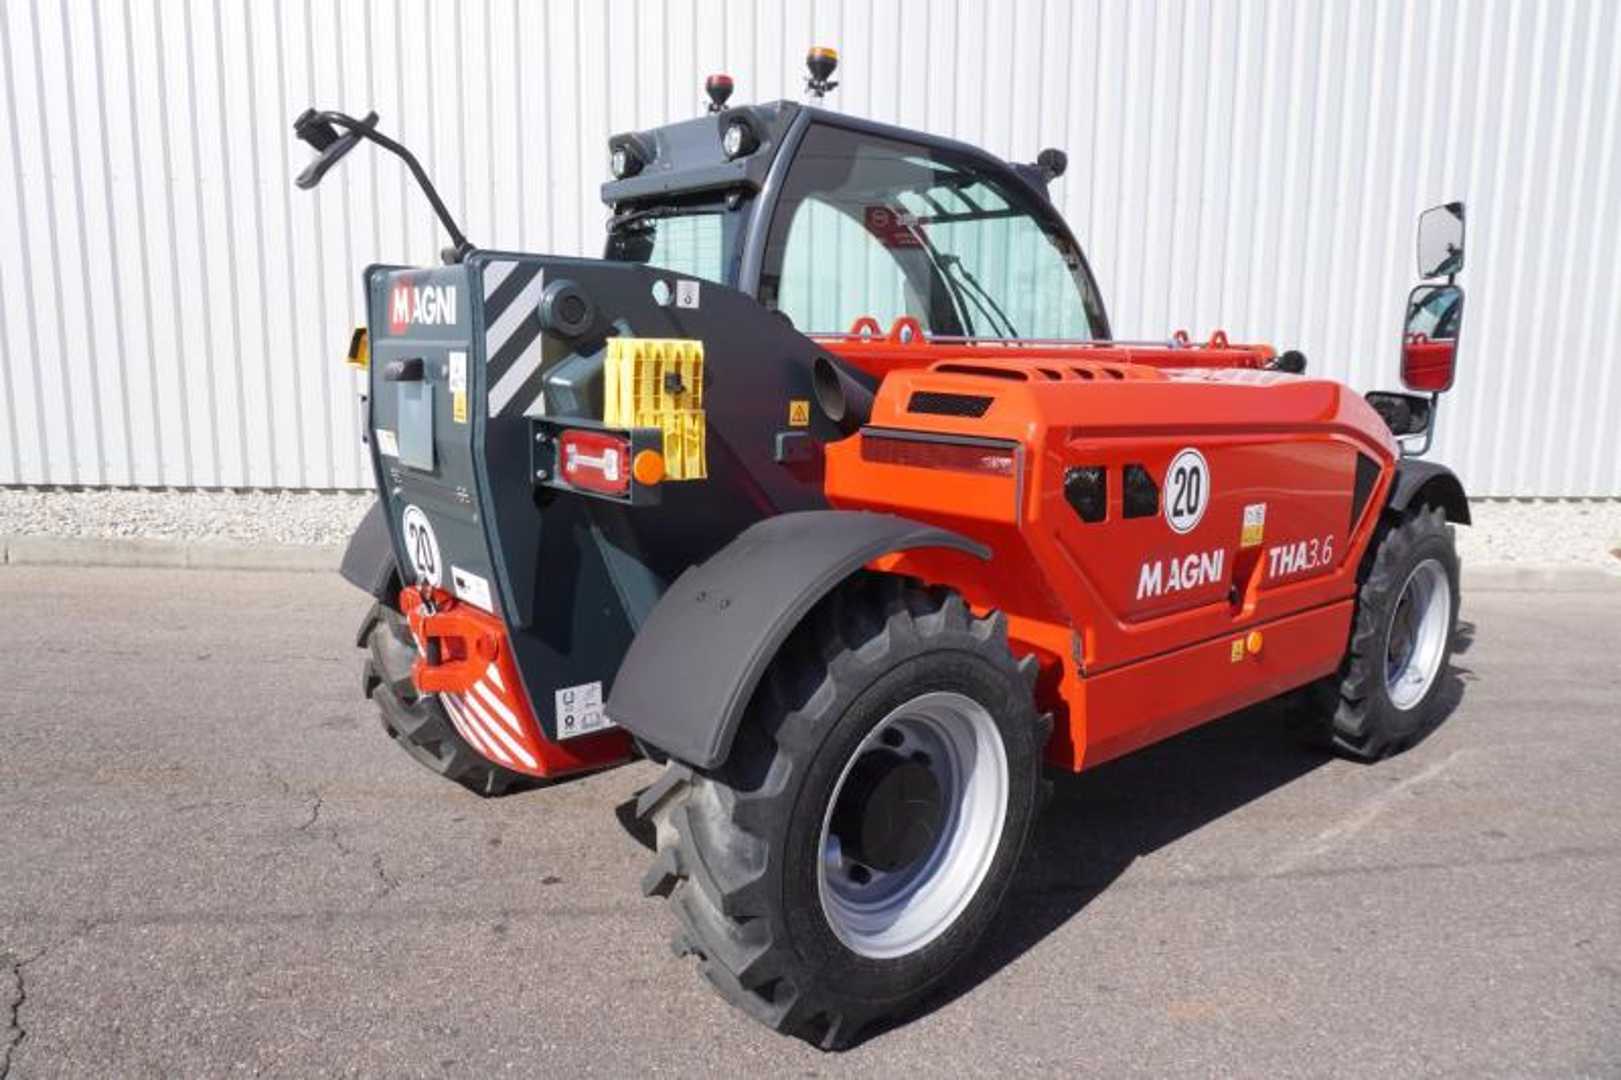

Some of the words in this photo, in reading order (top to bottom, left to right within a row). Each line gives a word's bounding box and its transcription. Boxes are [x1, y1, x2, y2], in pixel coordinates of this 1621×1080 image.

[392, 285, 456, 325] MAGNI
[1172, 466, 1200, 518] 20
[409, 523, 435, 574] 20
[1136, 548, 1225, 600] MAGNI
